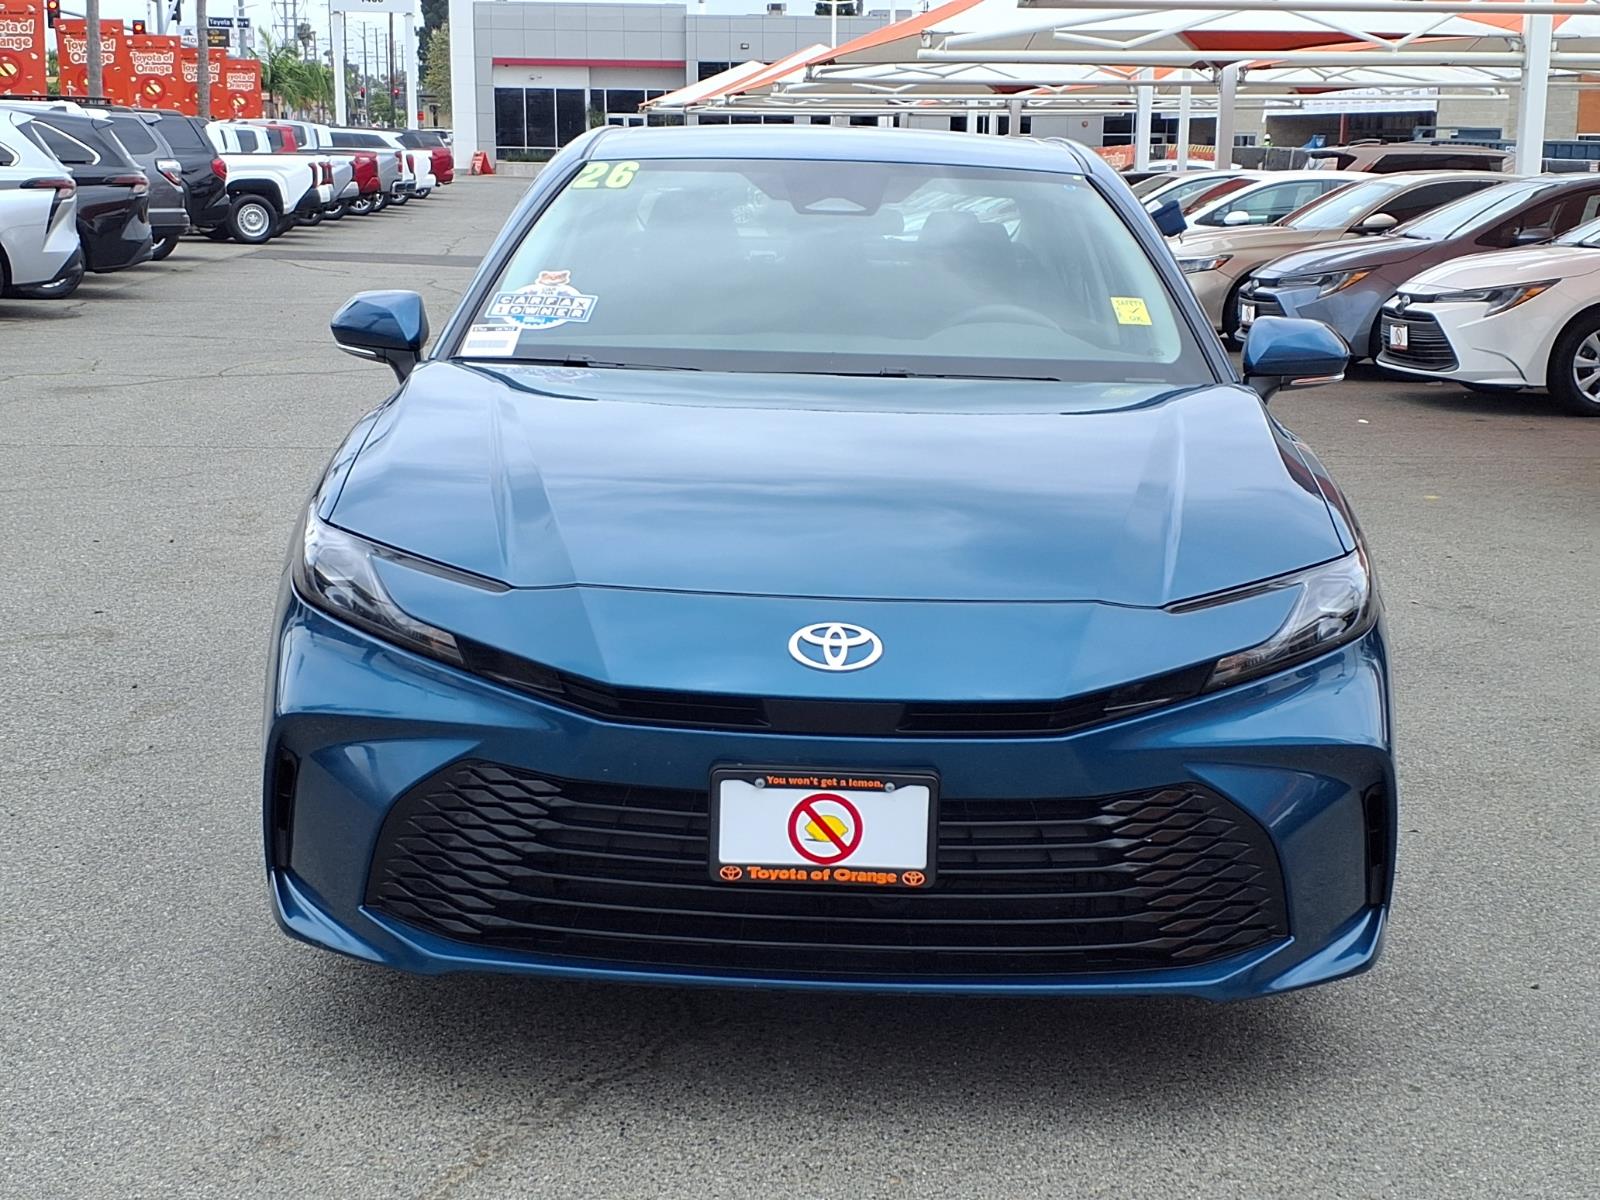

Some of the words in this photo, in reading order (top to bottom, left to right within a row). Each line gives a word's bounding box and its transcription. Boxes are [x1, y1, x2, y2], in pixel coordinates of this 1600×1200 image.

[20, 20, 33, 33] of
[103, 39, 115, 50] of
[131, 52, 162, 63] Toyota
[163, 52, 173, 62] of
[136, 64, 171, 74] Orange
[210, 63, 219, 72] of
[572, 161, 640, 188] 26
[499, 295, 585, 308] CARFAX
[510, 305, 584, 318] OWNER
[766, 775, 786, 785] You
[788, 776, 818, 786] won't
[820, 778, 838, 788] get
[848, 778, 884, 788] lemon.
[746, 866, 807, 880] Toyota
[810, 868, 831, 881] of
[833, 868, 897, 884] Orange
